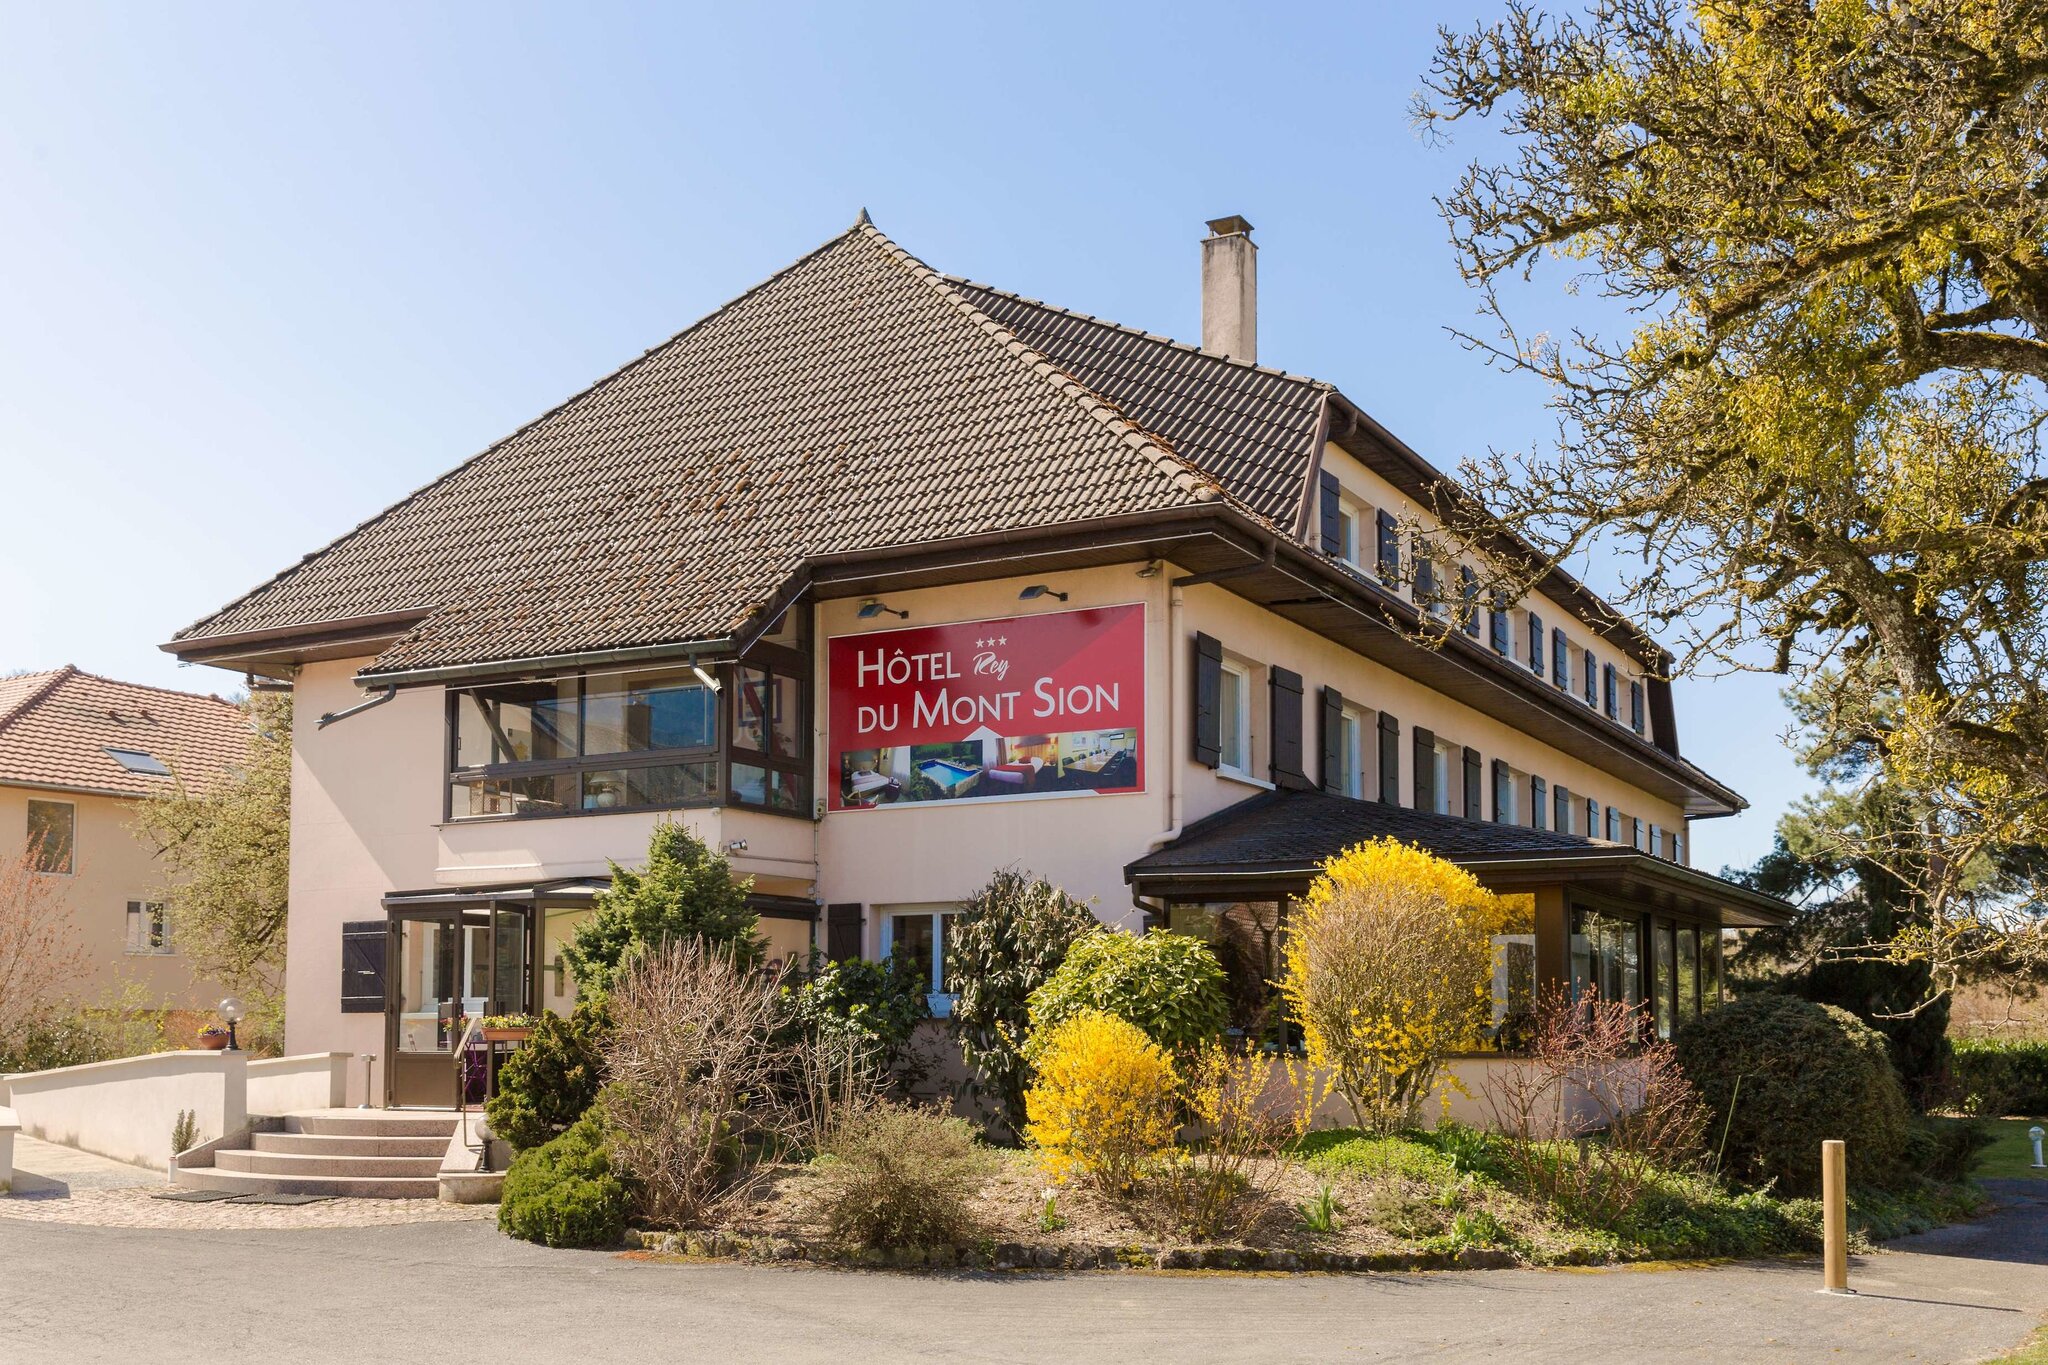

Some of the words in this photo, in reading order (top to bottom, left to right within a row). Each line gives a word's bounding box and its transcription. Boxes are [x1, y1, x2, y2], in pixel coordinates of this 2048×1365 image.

[858, 648, 961, 688] HÔTEL
[973, 651, 1010, 681] Rey
[858, 703, 899, 734] DU
[912, 688, 1021, 729] MONT
[1033, 676, 1119, 718] SION
